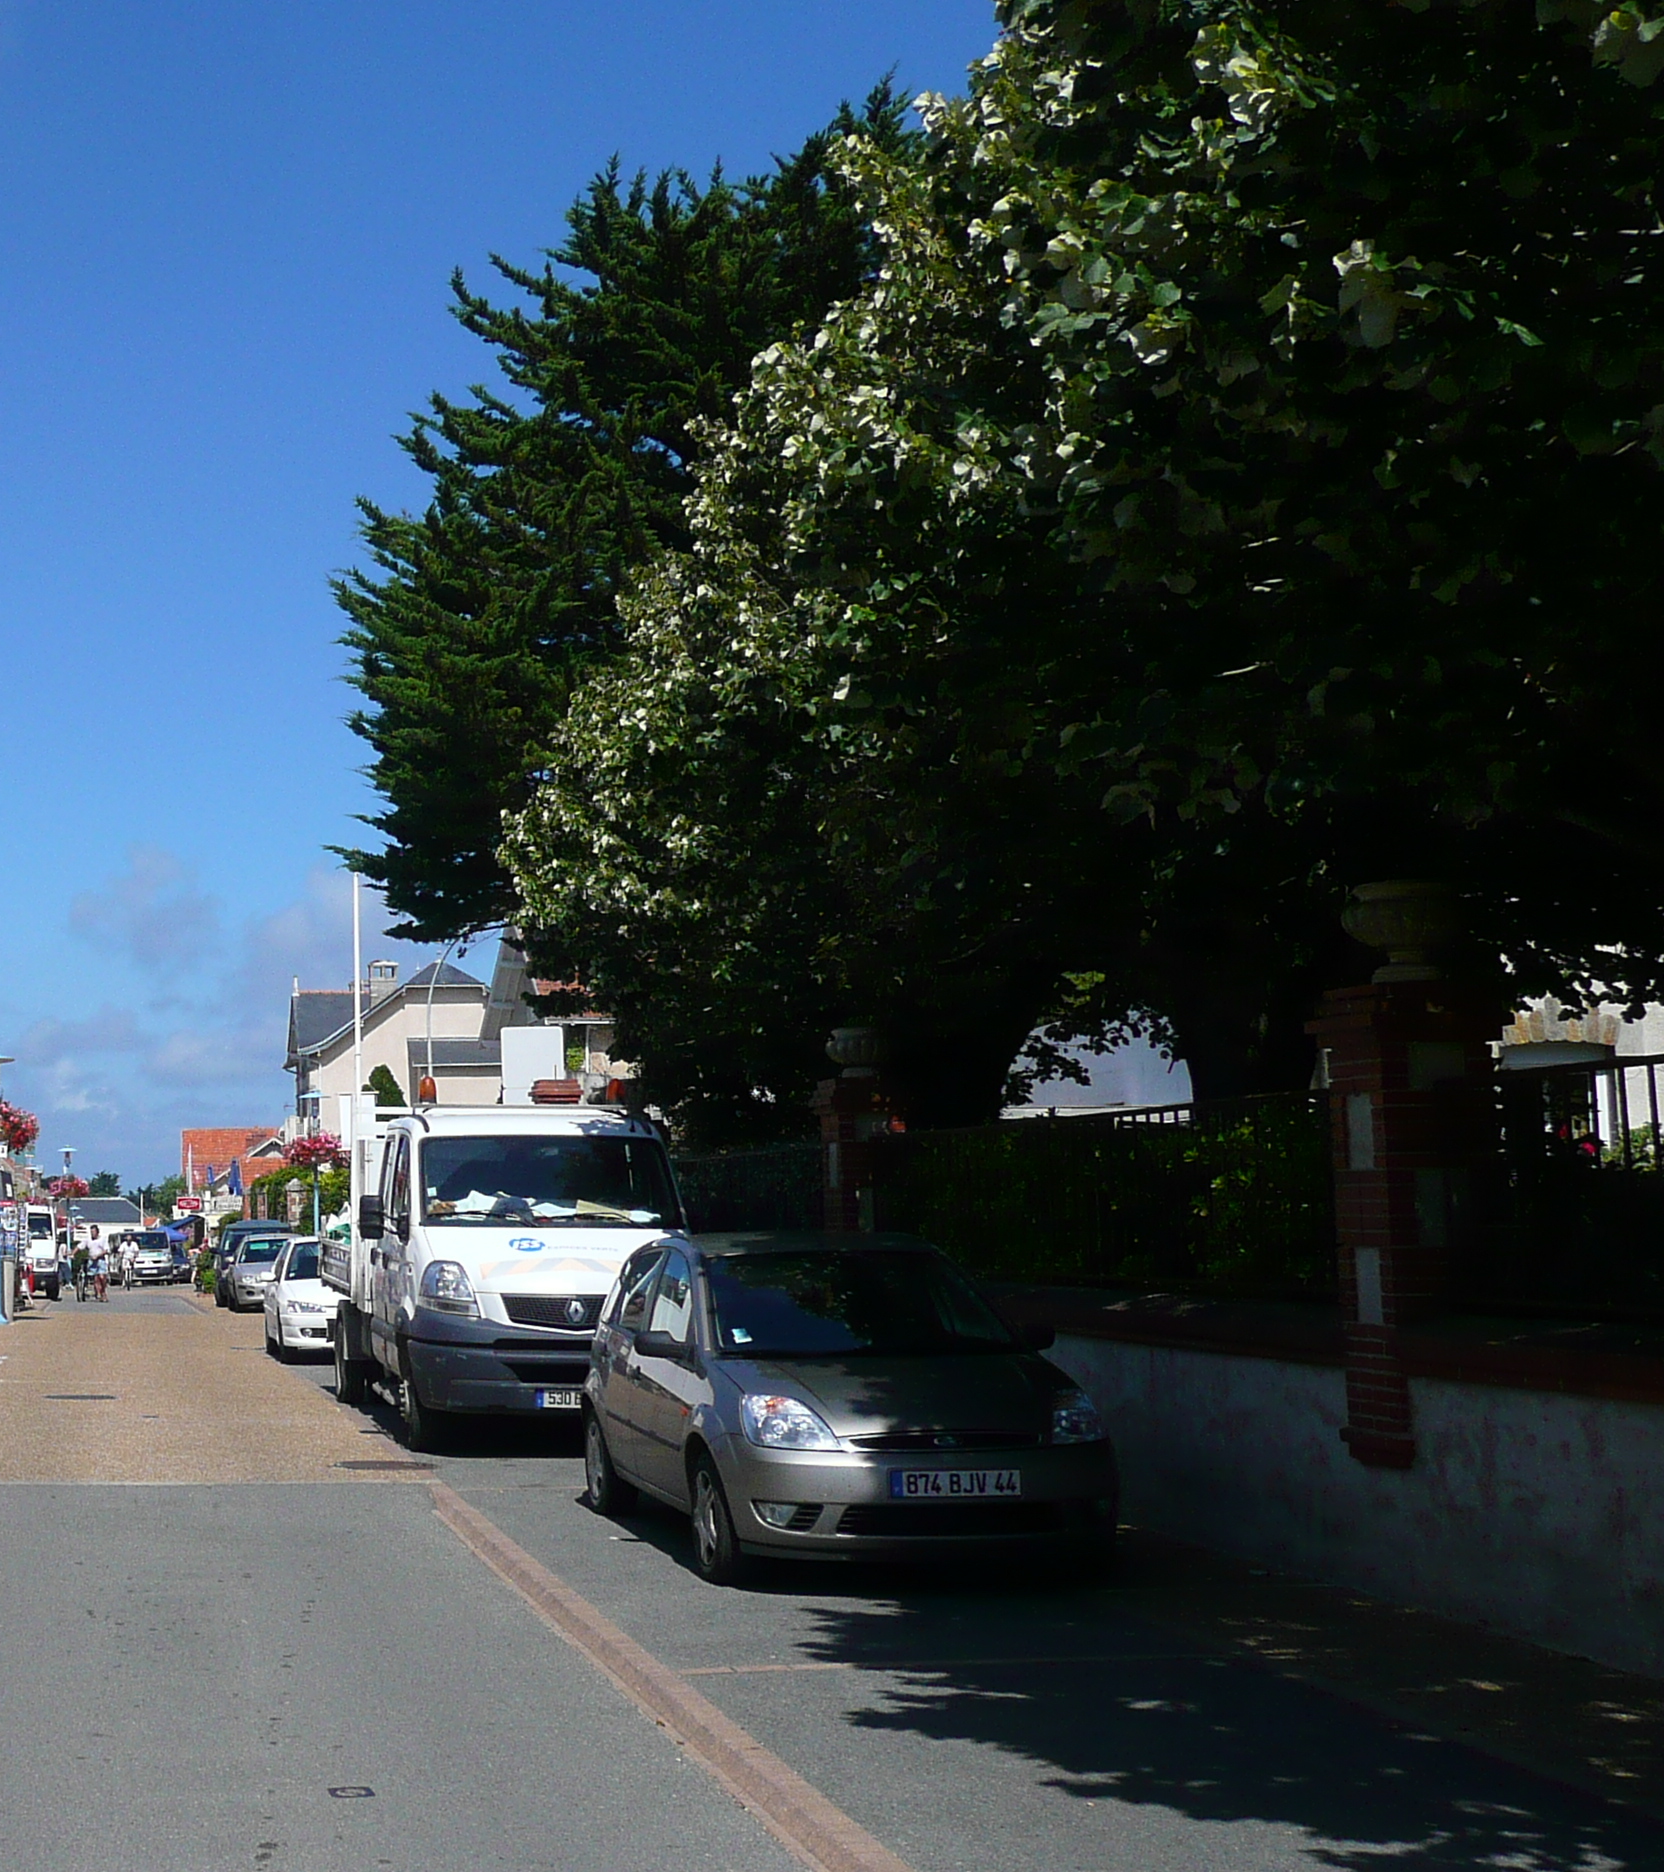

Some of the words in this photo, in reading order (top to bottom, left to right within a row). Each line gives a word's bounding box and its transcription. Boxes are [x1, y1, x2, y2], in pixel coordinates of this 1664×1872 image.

[906, 1473, 942, 1494] 874
[949, 1472, 987, 1494] BJV
[995, 1472, 1017, 1493] 44
